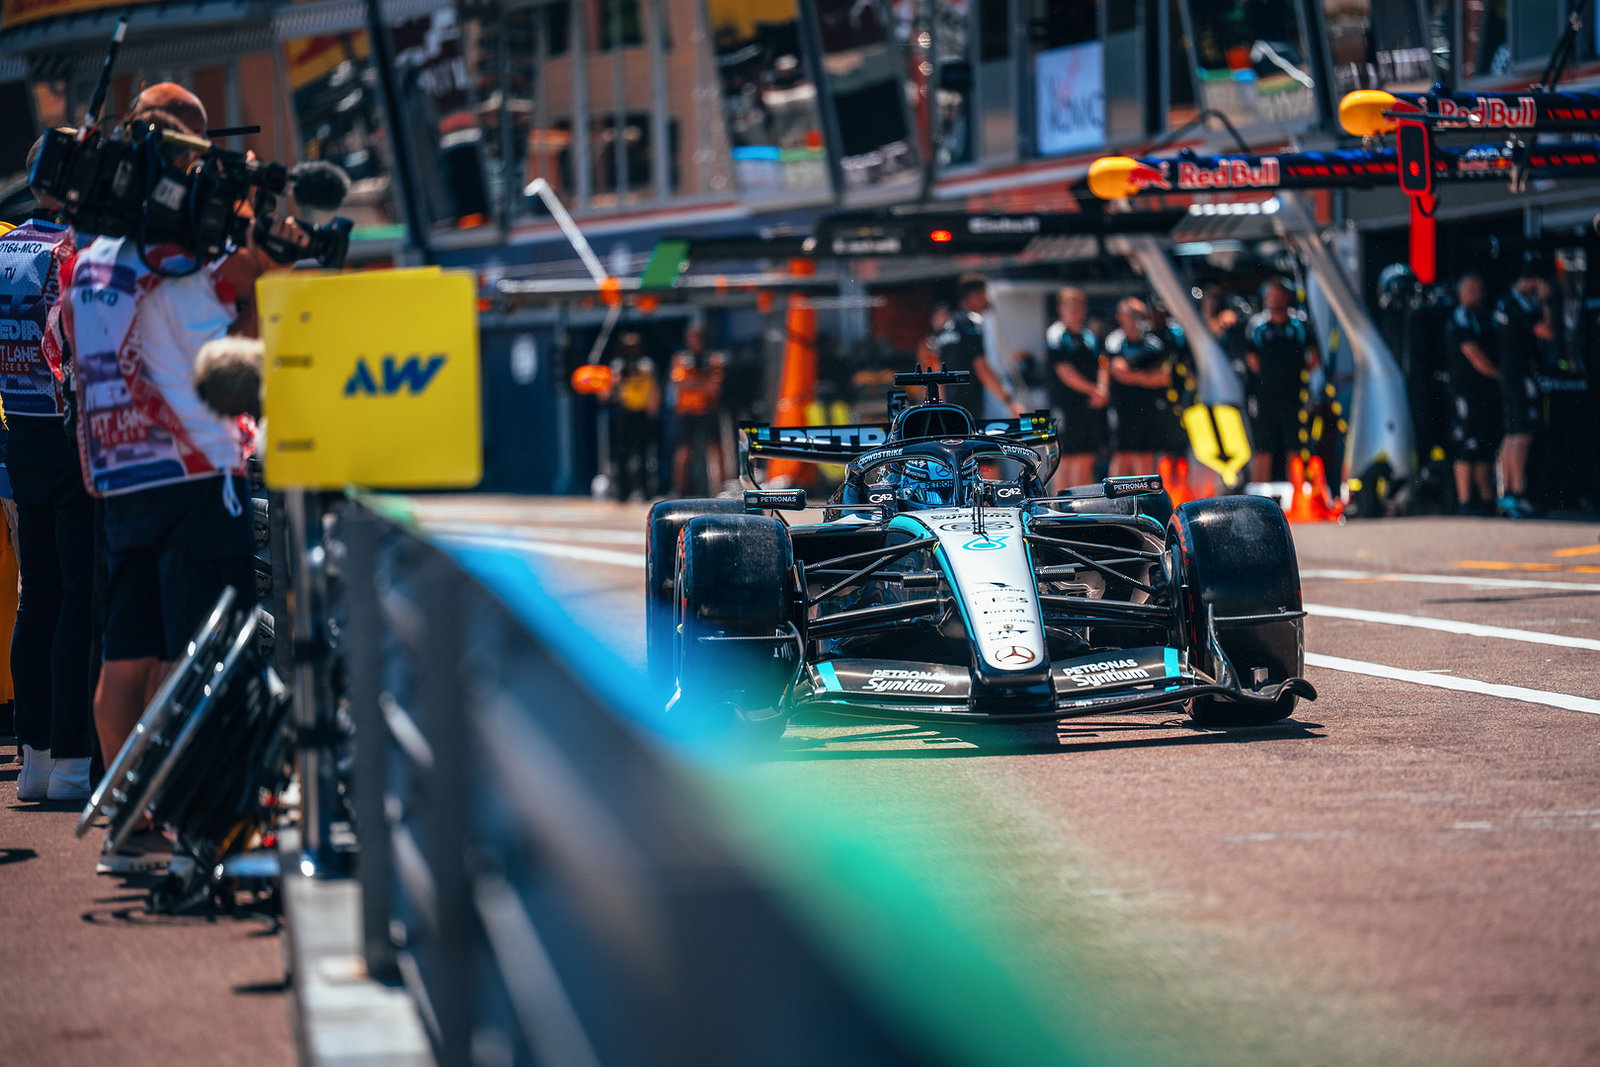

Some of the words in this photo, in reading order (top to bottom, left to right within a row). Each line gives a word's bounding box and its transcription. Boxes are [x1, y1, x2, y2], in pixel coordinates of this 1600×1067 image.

[1487, 97, 1536, 128] Bull
[1178, 159, 1230, 189] Red
[1230, 157, 1279, 187] Bull
[4, 267, 16, 280] TV
[0, 319, 43, 341] EDIA
[7, 346, 40, 363] LANE
[0, 362, 30, 372] CCESS
[1113, 481, 1149, 491] PETRONAS
[760, 496, 797, 504] PETRONAS
[1062, 659, 1139, 676] PETRONAS
[862, 677, 946, 693] Syntium
[1070, 667, 1150, 688] Syntium
